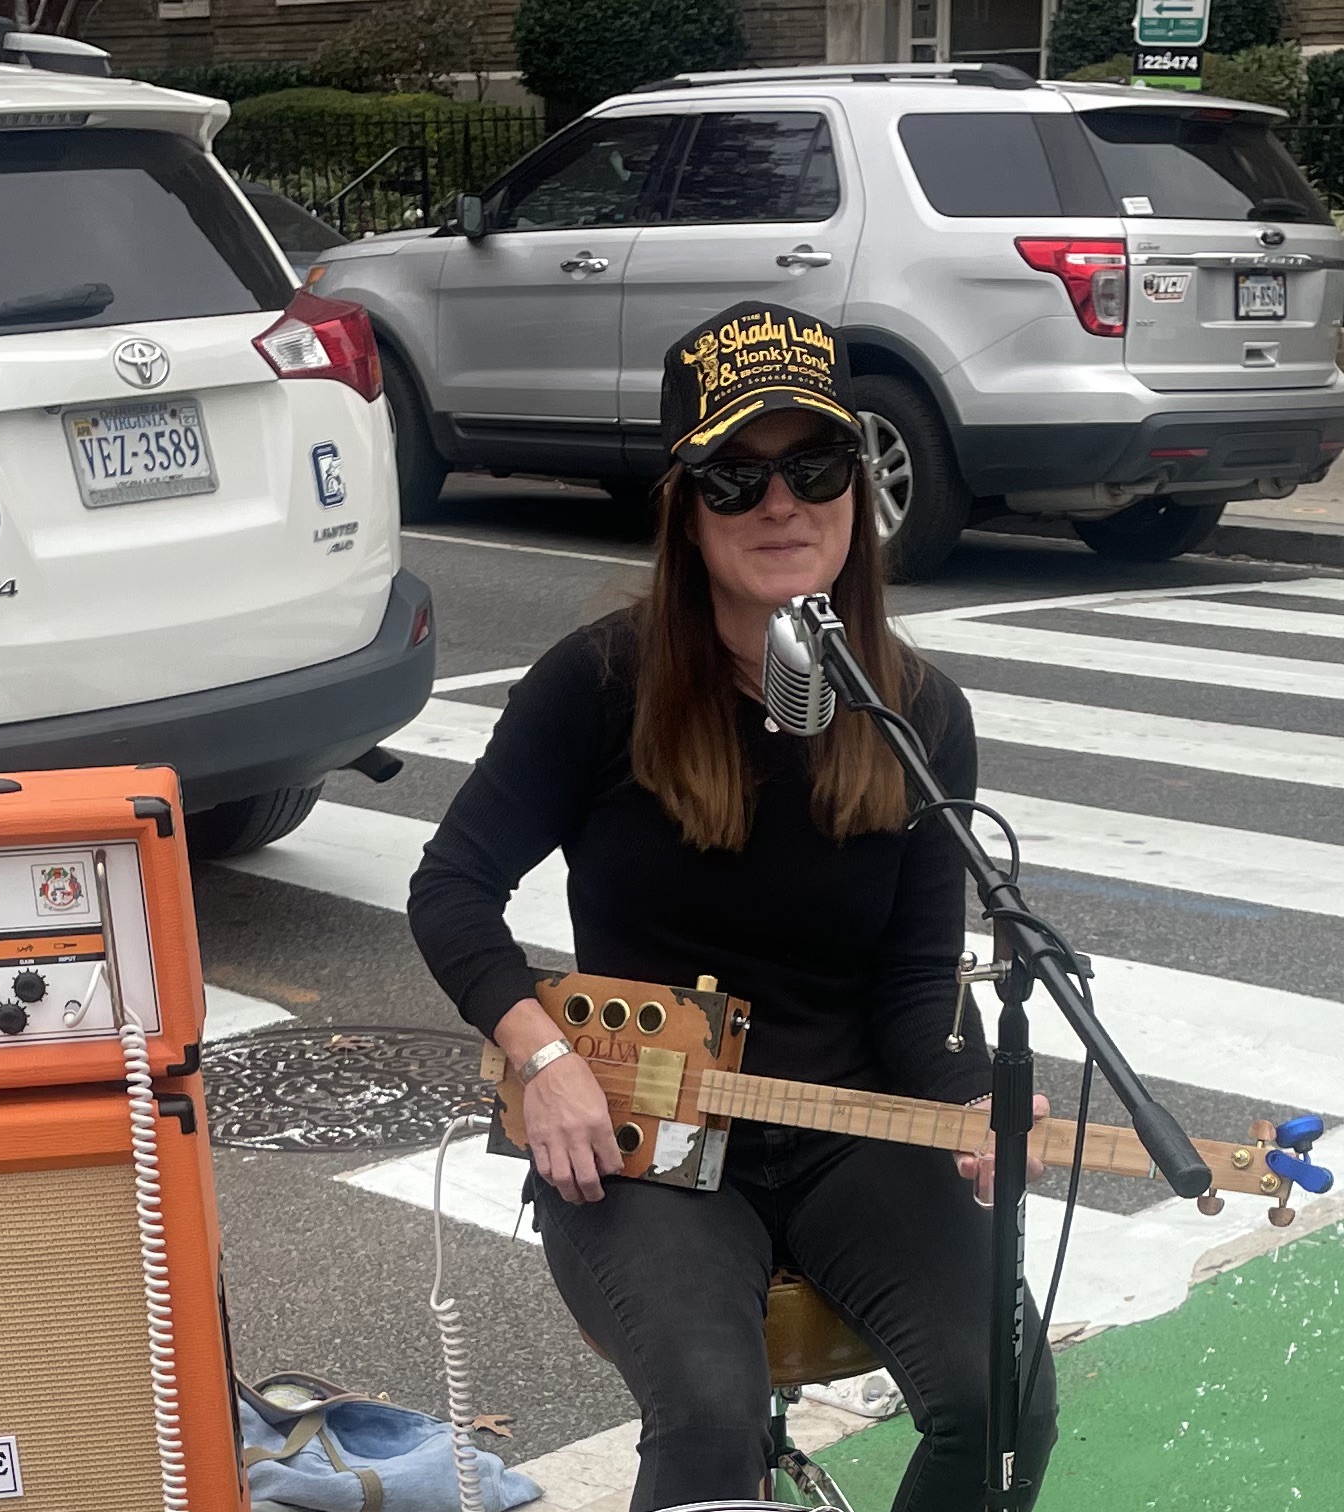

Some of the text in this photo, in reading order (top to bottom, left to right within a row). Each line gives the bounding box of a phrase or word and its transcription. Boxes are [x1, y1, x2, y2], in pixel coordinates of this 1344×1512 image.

[1144, 55, 1198, 70] 225474
[1158, 277, 1186, 292] VCU
[741, 313, 761, 322] THE
[719, 311, 835, 365] Shady Lady
[720, 362, 833, 387] & BOOT SCOOT
[103, 412, 169, 432] VIRGINIA
[80, 426, 200, 480] VEZ-3589
[574, 1032, 639, 1065] OLIVA
